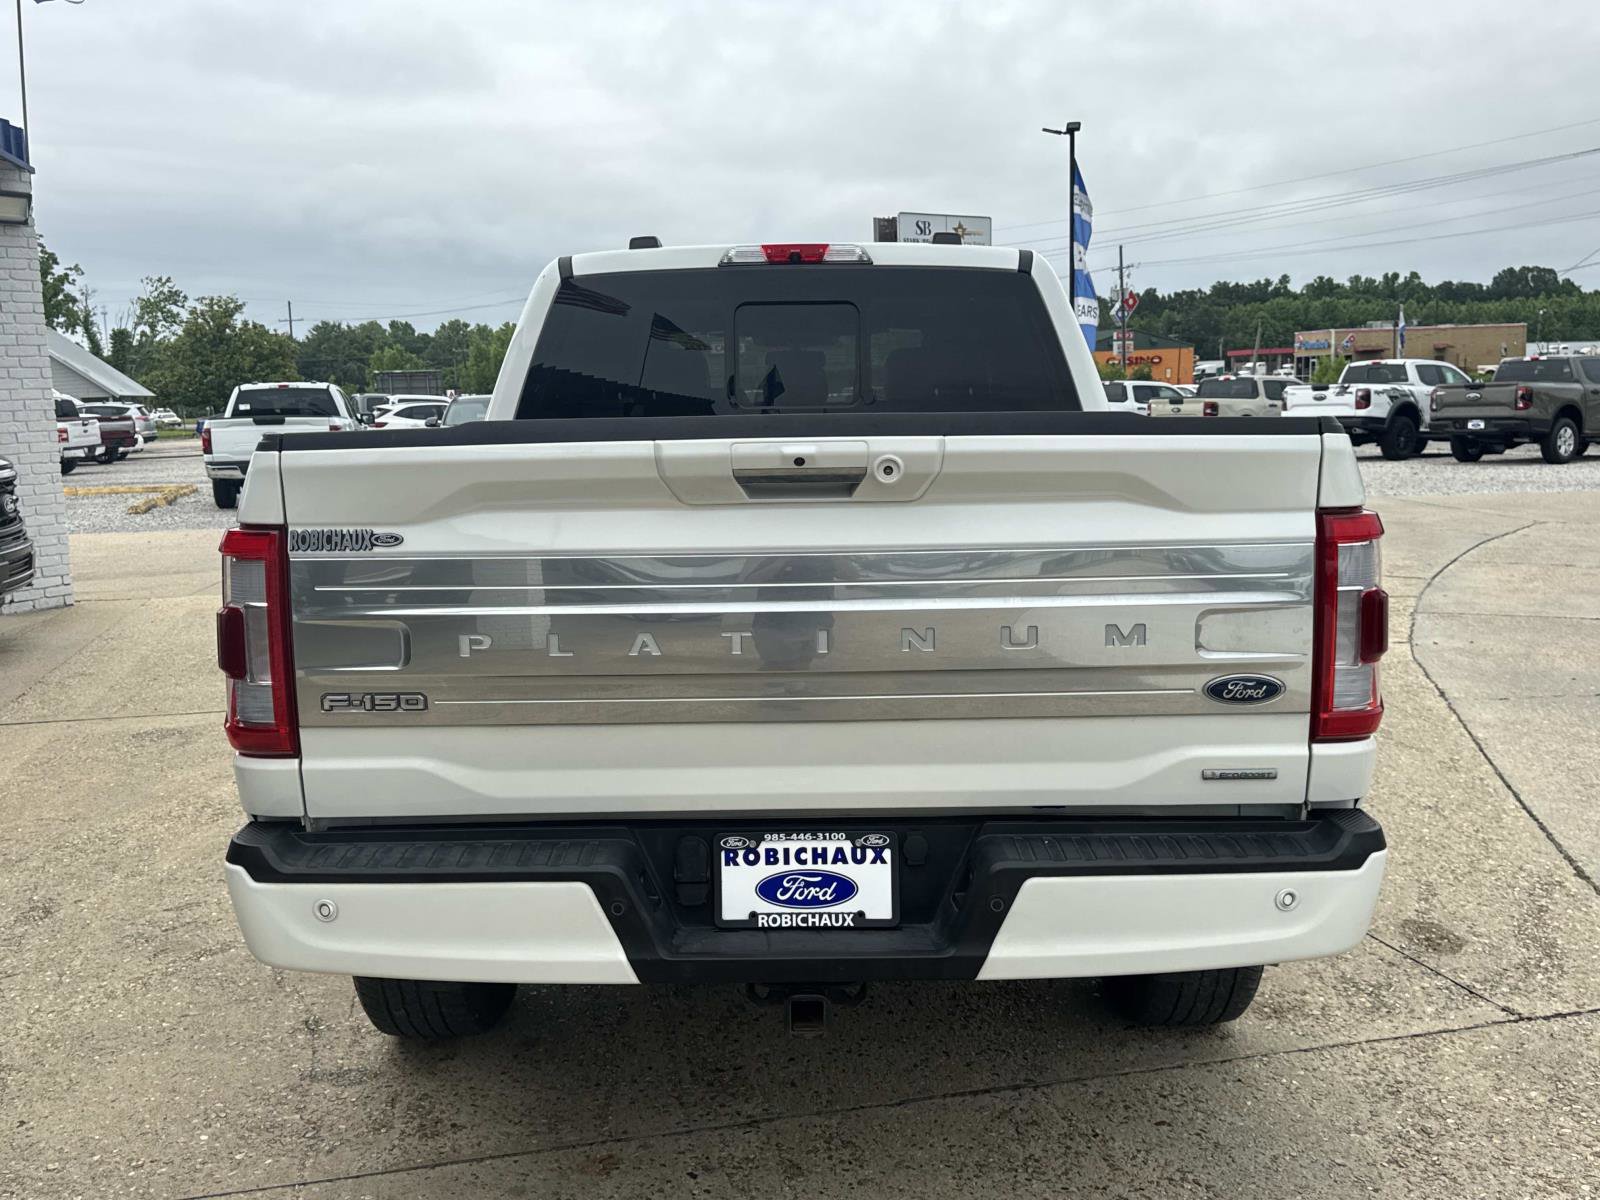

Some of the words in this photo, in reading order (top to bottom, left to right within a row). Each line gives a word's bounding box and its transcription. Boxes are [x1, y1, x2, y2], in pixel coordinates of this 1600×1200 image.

[915, 219, 932, 236] SB
[289, 529, 374, 551] ROBICHAUX
[458, 622, 1148, 658] PLATINUM
[1223, 680, 1267, 699] Ford
[320, 691, 428, 713] F-150
[763, 832, 846, 842] 985-446-3100
[724, 846, 889, 867] ROBICHAUX
[776, 874, 838, 901] Ford
[757, 913, 855, 928] ROBICHAUX
